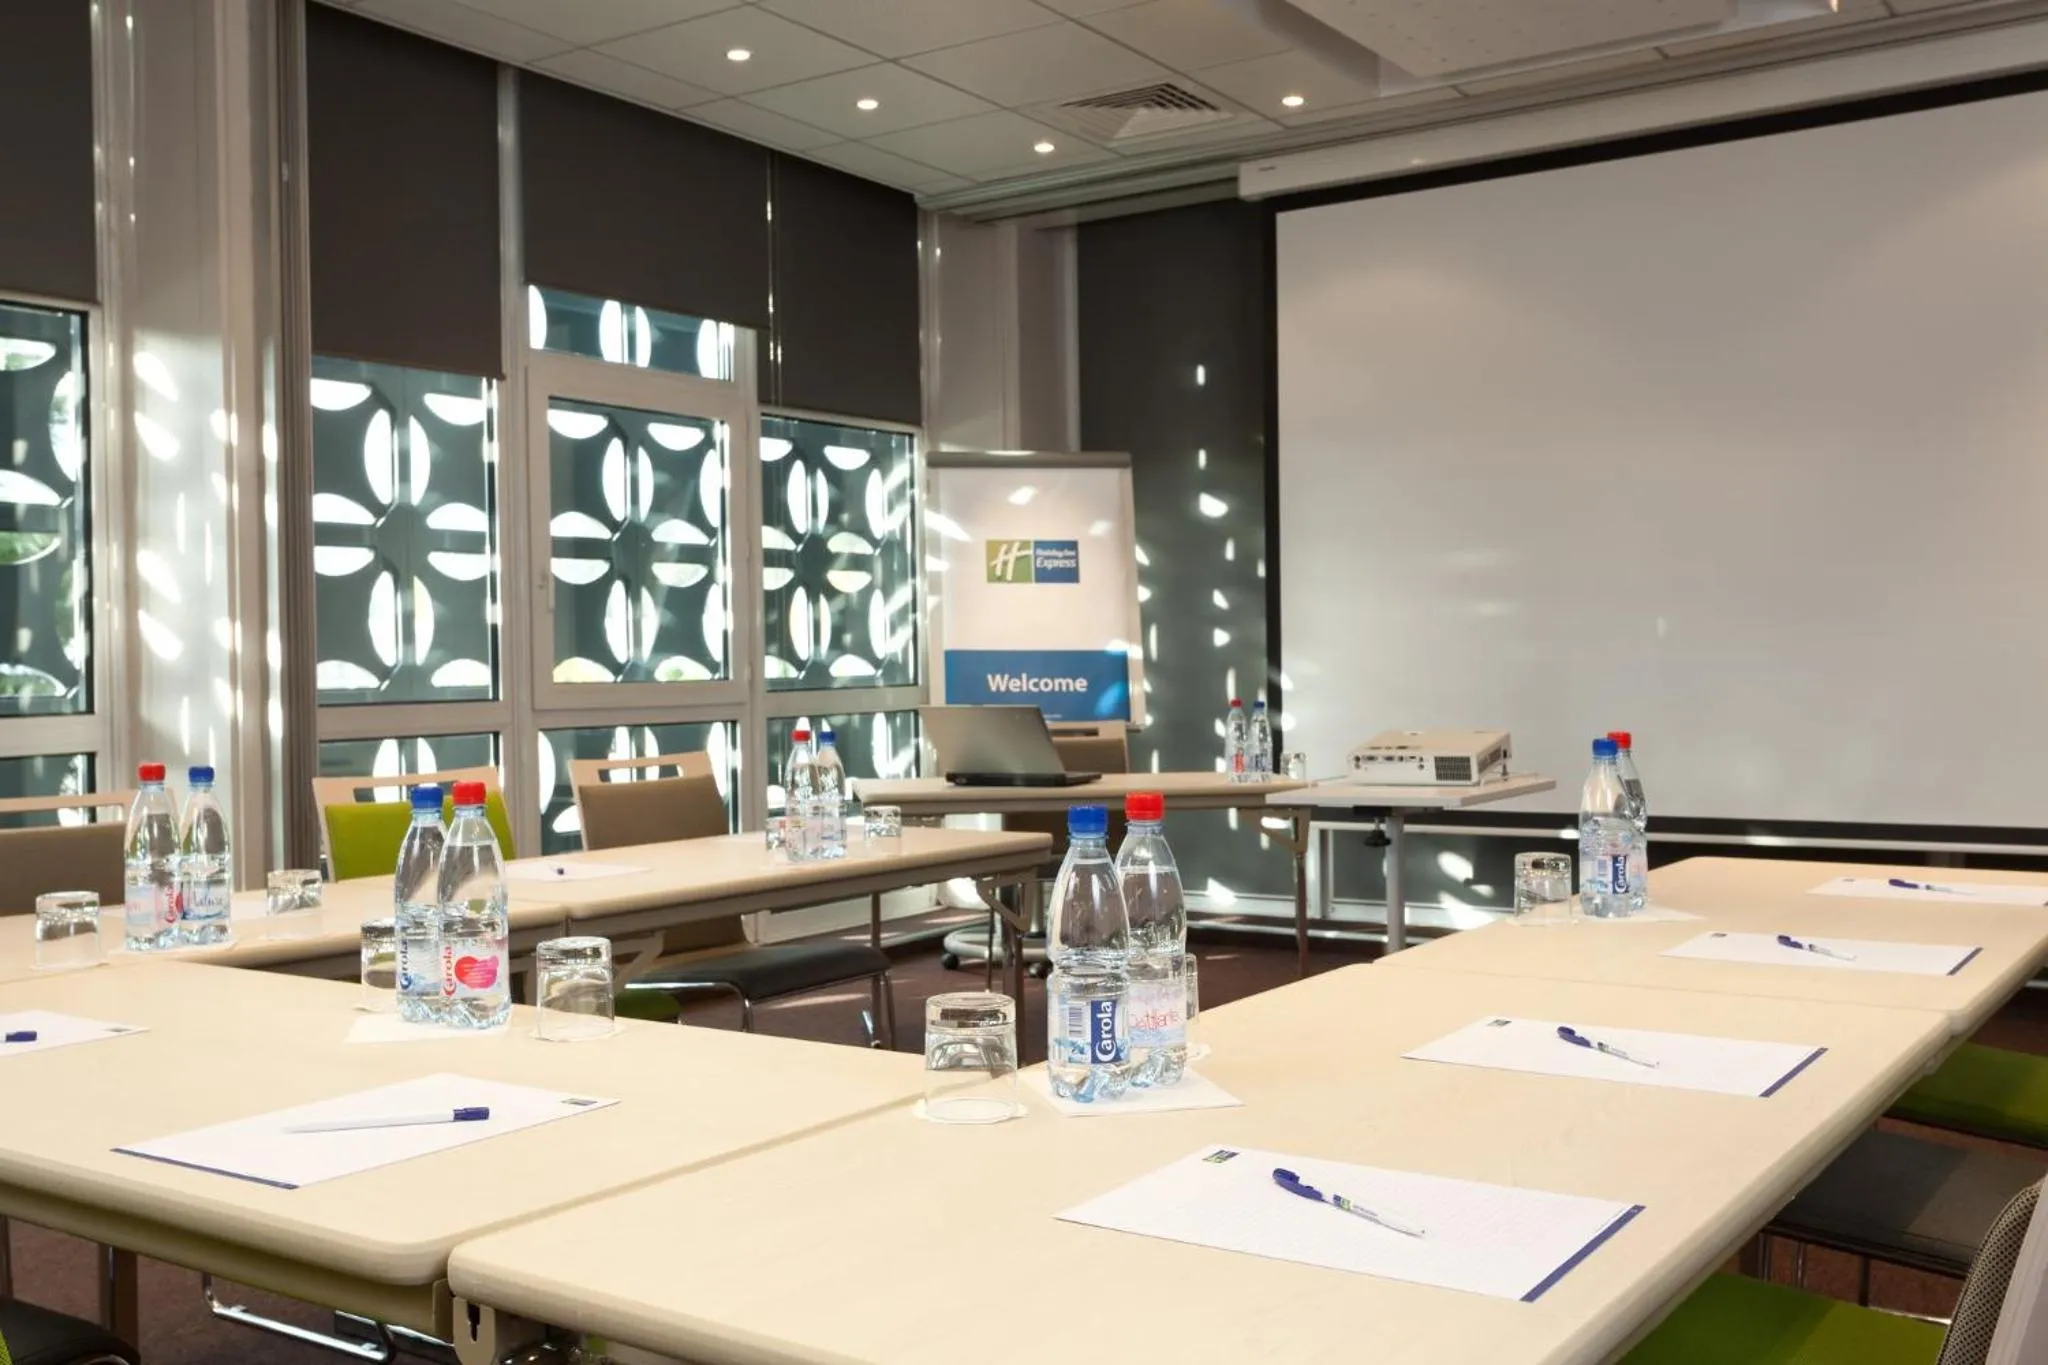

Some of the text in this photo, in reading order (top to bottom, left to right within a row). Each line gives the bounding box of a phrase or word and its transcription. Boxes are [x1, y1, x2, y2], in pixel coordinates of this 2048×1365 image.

[1036, 557, 1076, 570] Express
[987, 673, 1088, 692] Welcome
[1614, 856, 1626, 893] Carola
[443, 946, 456, 996] Carola
[1095, 1001, 1117, 1062] Carola
